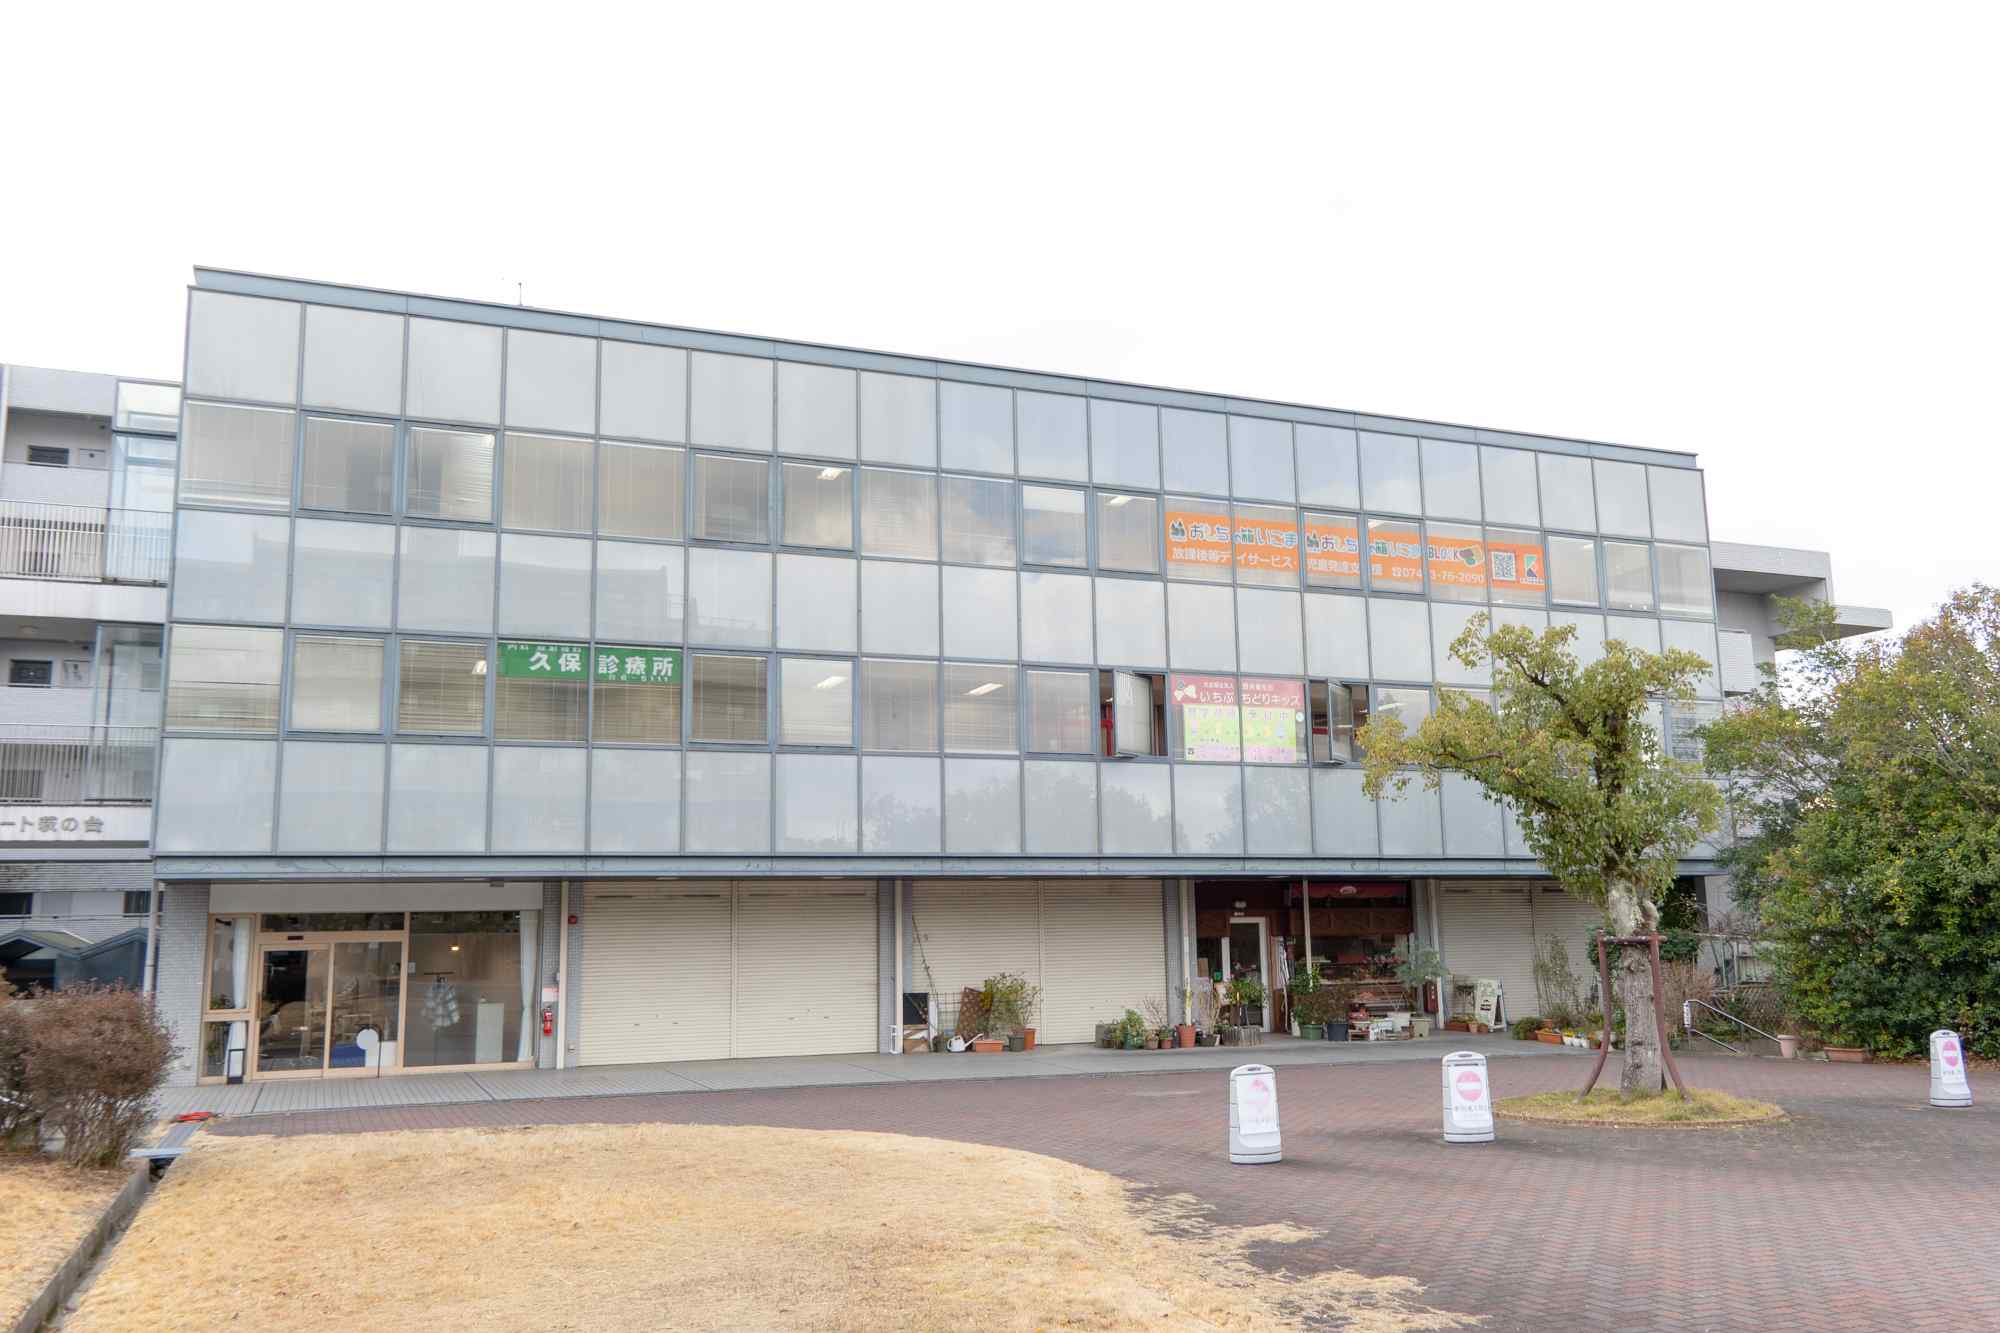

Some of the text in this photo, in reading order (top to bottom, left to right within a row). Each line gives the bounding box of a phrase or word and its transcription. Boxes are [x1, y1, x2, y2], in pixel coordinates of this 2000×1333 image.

[528, 651, 673, 677] 久保診療所
